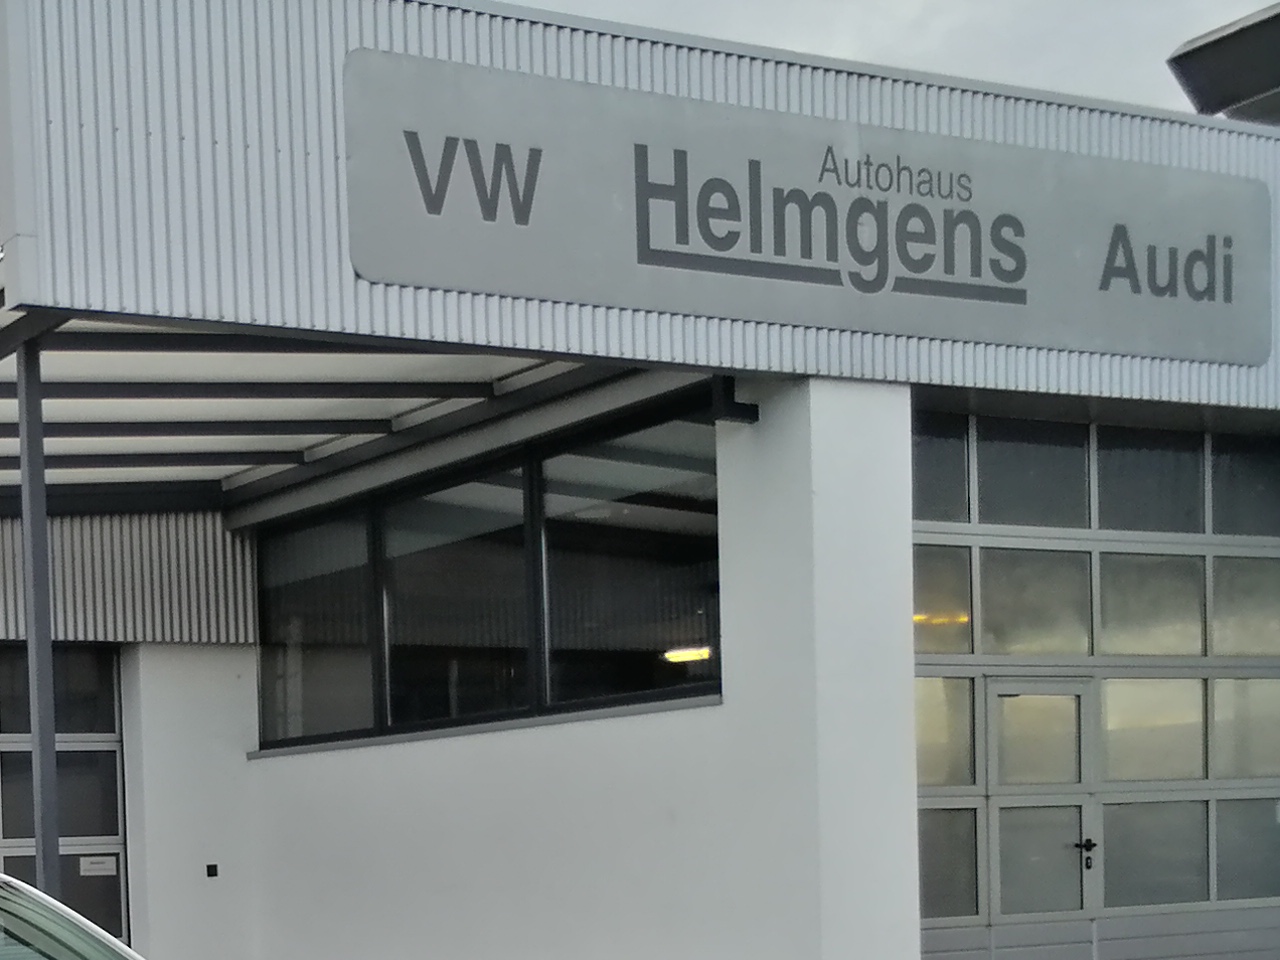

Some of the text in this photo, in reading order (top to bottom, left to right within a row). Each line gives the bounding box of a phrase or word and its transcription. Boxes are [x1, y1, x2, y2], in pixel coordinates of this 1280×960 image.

[403, 130, 543, 226] VW
[818, 145, 973, 202] Autohaus
[634, 143, 1028, 294] Helmgens
[1099, 223, 1233, 304] Audi
